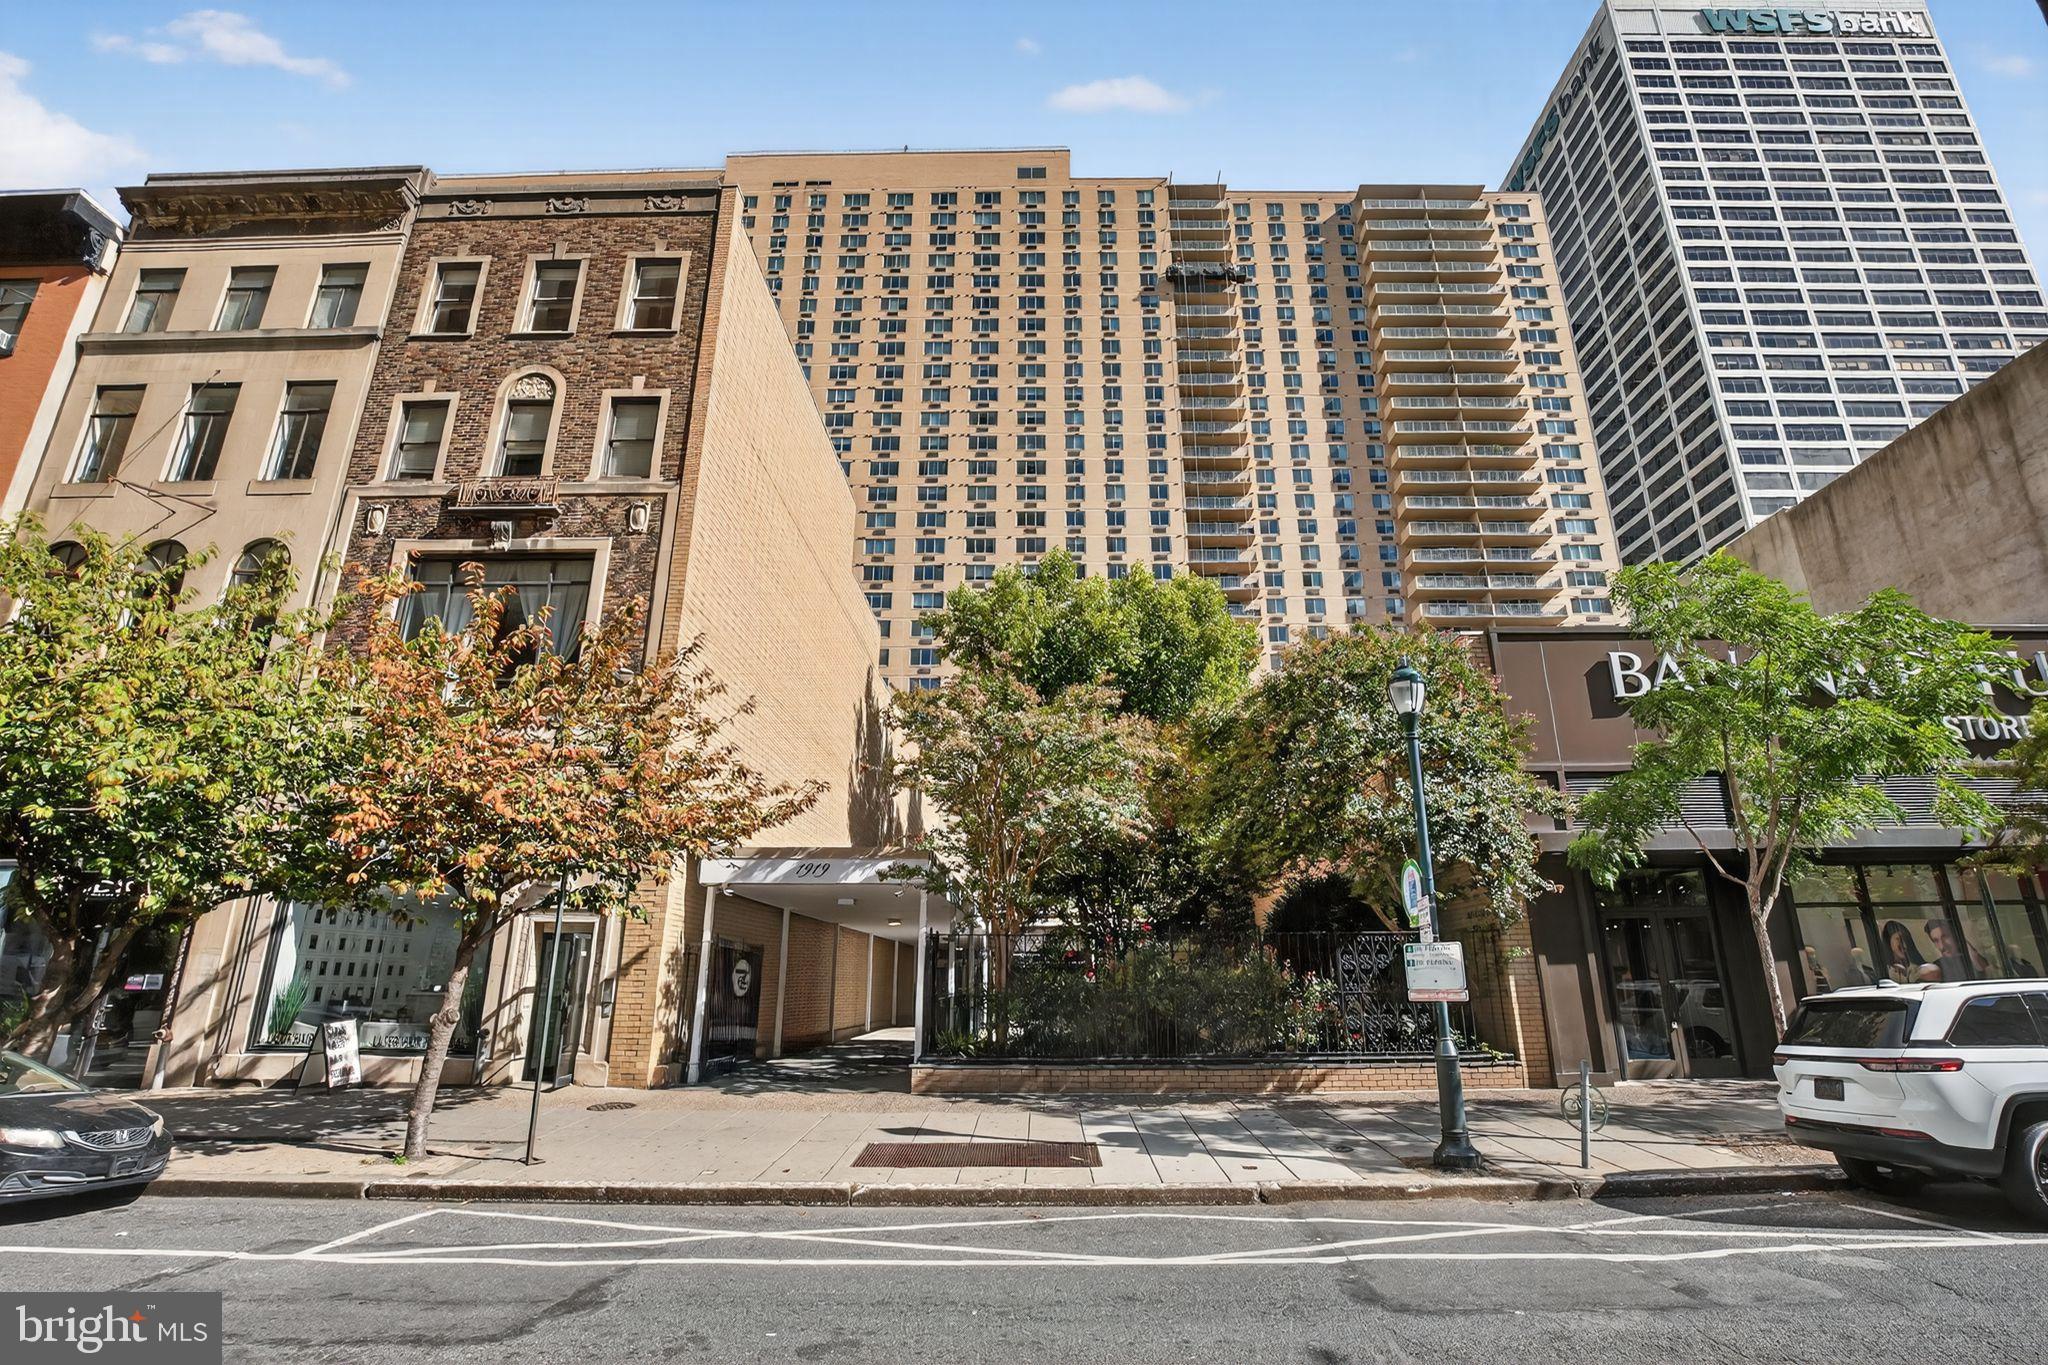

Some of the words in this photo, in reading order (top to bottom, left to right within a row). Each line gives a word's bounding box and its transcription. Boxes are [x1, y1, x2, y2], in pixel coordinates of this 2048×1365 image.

[1701, 8, 1833, 34] WSFS
[1829, 10, 1923, 35] bank
[1557, 35, 1604, 118] bank
[796, 863, 830, 878] 1919
